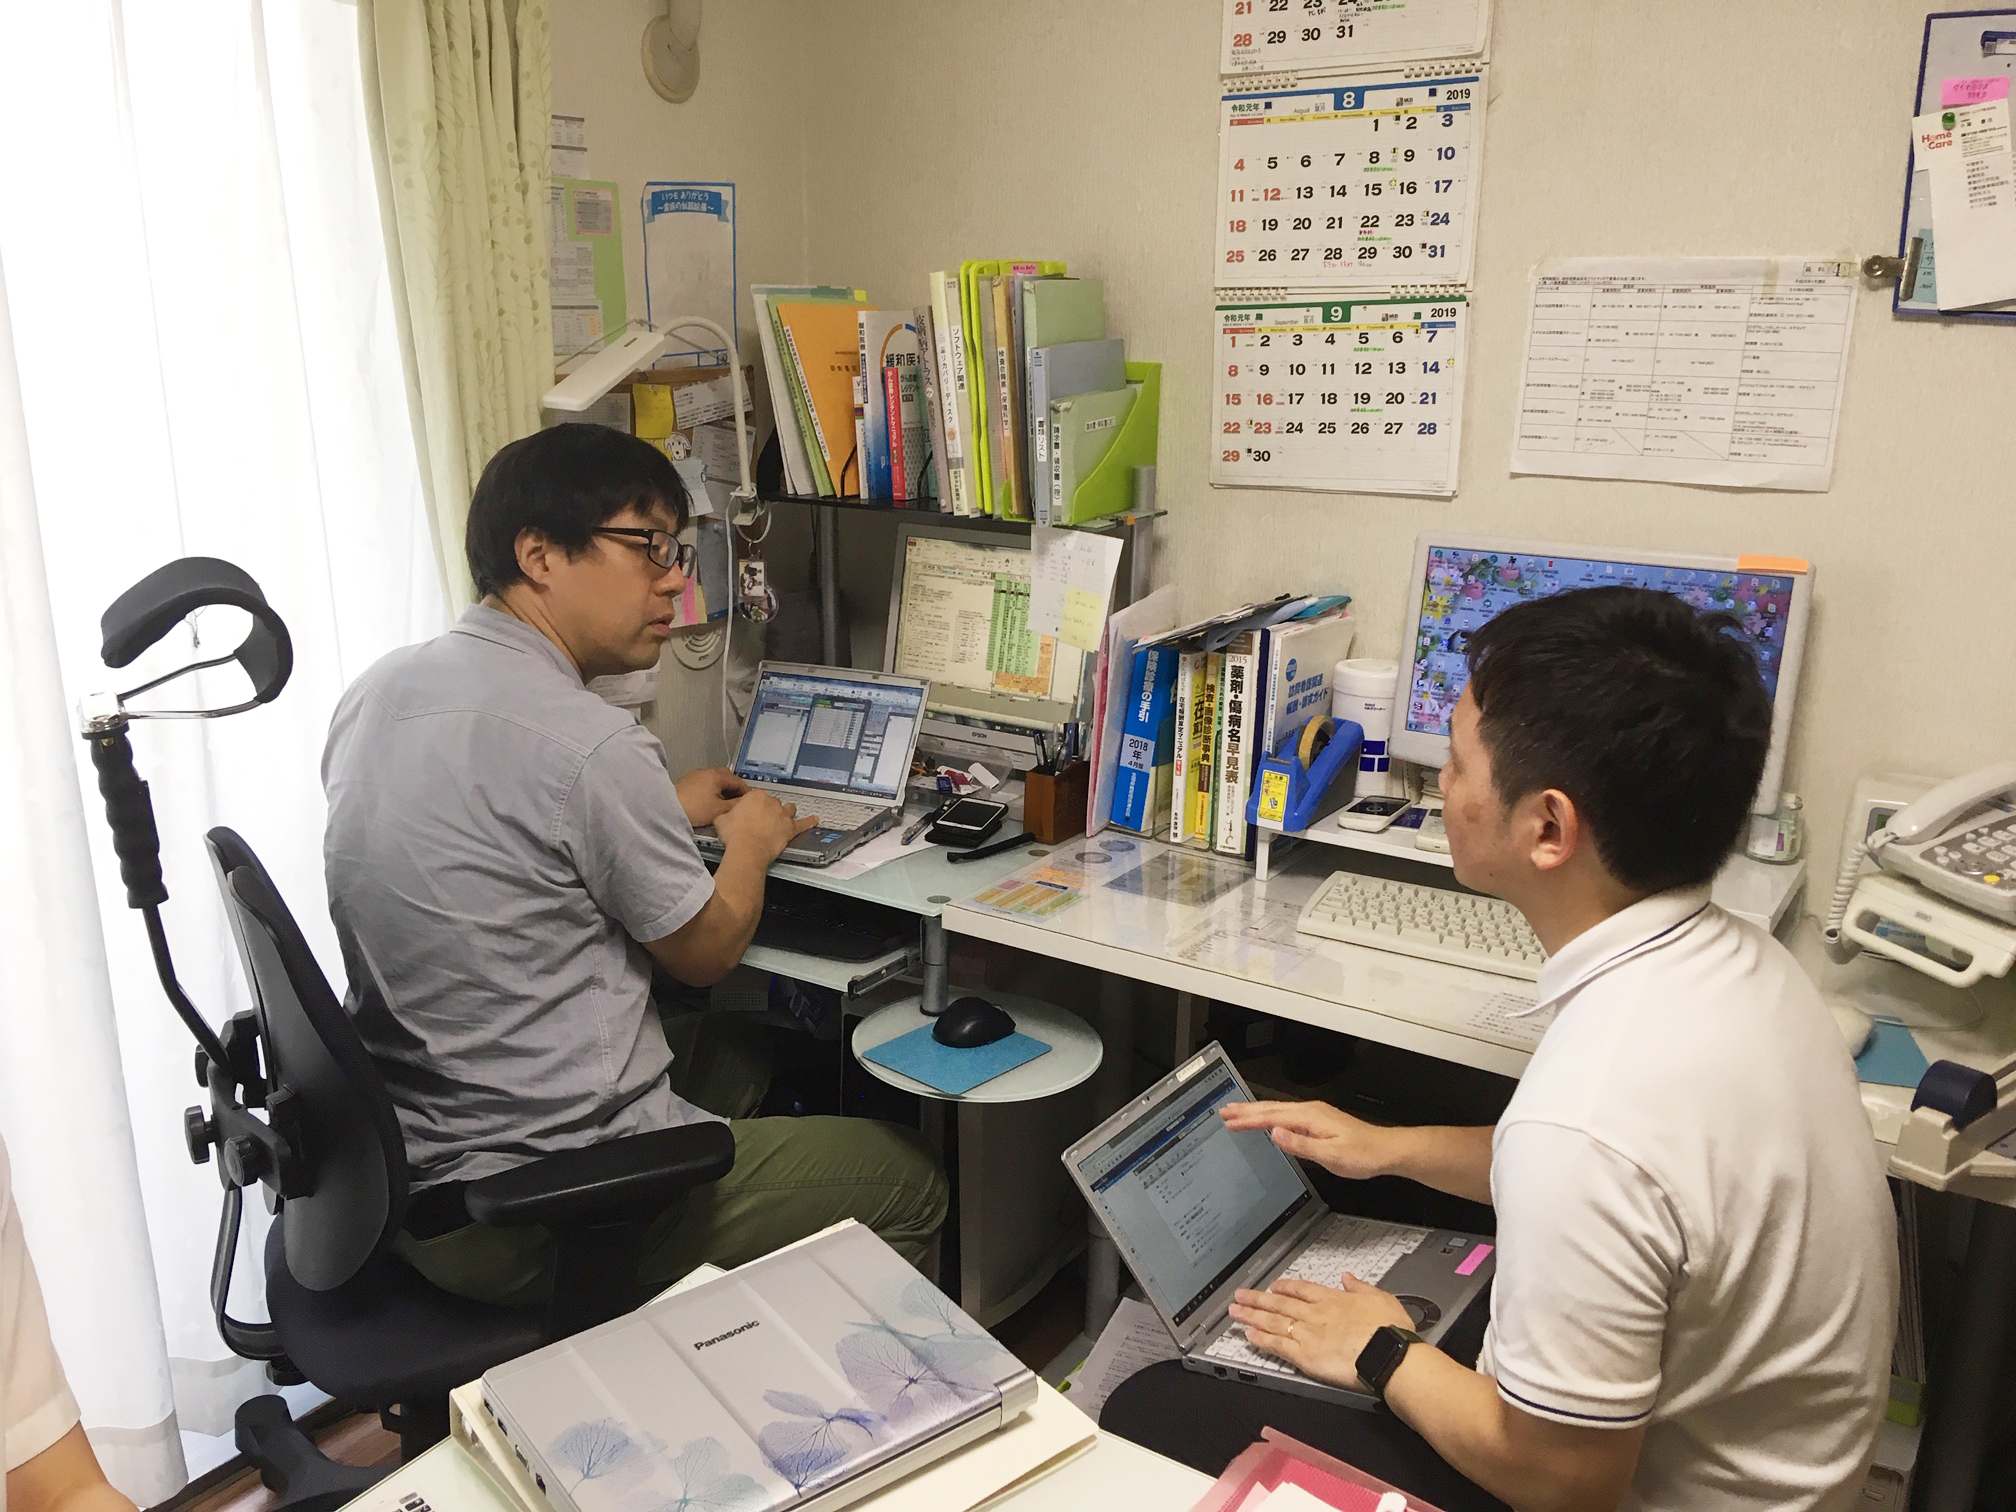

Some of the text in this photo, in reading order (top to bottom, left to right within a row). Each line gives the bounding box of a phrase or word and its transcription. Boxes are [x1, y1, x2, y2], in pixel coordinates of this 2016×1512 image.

[1235, 1, 1251, 15] 21
[1233, 25, 1353, 47] 28 29 30 31
[1342, 91, 1355, 108] 8
[1446, 88, 1471, 100] 2019
[1231, 103, 1260, 112] 令和元年
[1374, 114, 1453, 131] 1 2 3
[1921, 131, 1952, 143] Home
[1928, 139, 1953, 150] Care
[1234, 147, 1455, 171] 4 5 6 7 8 9 10
[661, 191, 709, 201] いつも ありがとう
[1231, 180, 1452, 202] 11 12 13 14 15 16 17
[1229, 213, 1450, 232] 18 19 20 21 22 23 24
[1226, 245, 1445, 263] 25 26 27 28 29 30 31
[1831, 263, 1841, 277] 4
[1224, 314, 1251, 322] 令和元年
[1330, 306, 1343, 321] 9
[1430, 308, 1456, 318] 2019
[1231, 330, 1437, 348] 1 2 3 4 5 6 7
[886, 353, 920, 367] 緩和医
[953, 328, 965, 390] ソフトウェア関連
[1228, 361, 1440, 377] 8 9 10 11 12 13 14
[1226, 392, 1436, 405] 15 16 17 18 19 20 21
[1223, 422, 1436, 435] 22 23 24 25 26 27 28
[1037, 420, 1045, 458] 書類リスト
[1222, 450, 1270, 462] 29 30
[1229, 655, 1248, 664] 2015
[1201, 683, 1215, 762] 検査・画像診断事典
[1225, 665, 1245, 784] 薬剤・傷病名早見表
[1129, 739, 1148, 751] 2018
[1132, 750, 1142, 760] 年
[693, 1319, 760, 1351] Panasonic
